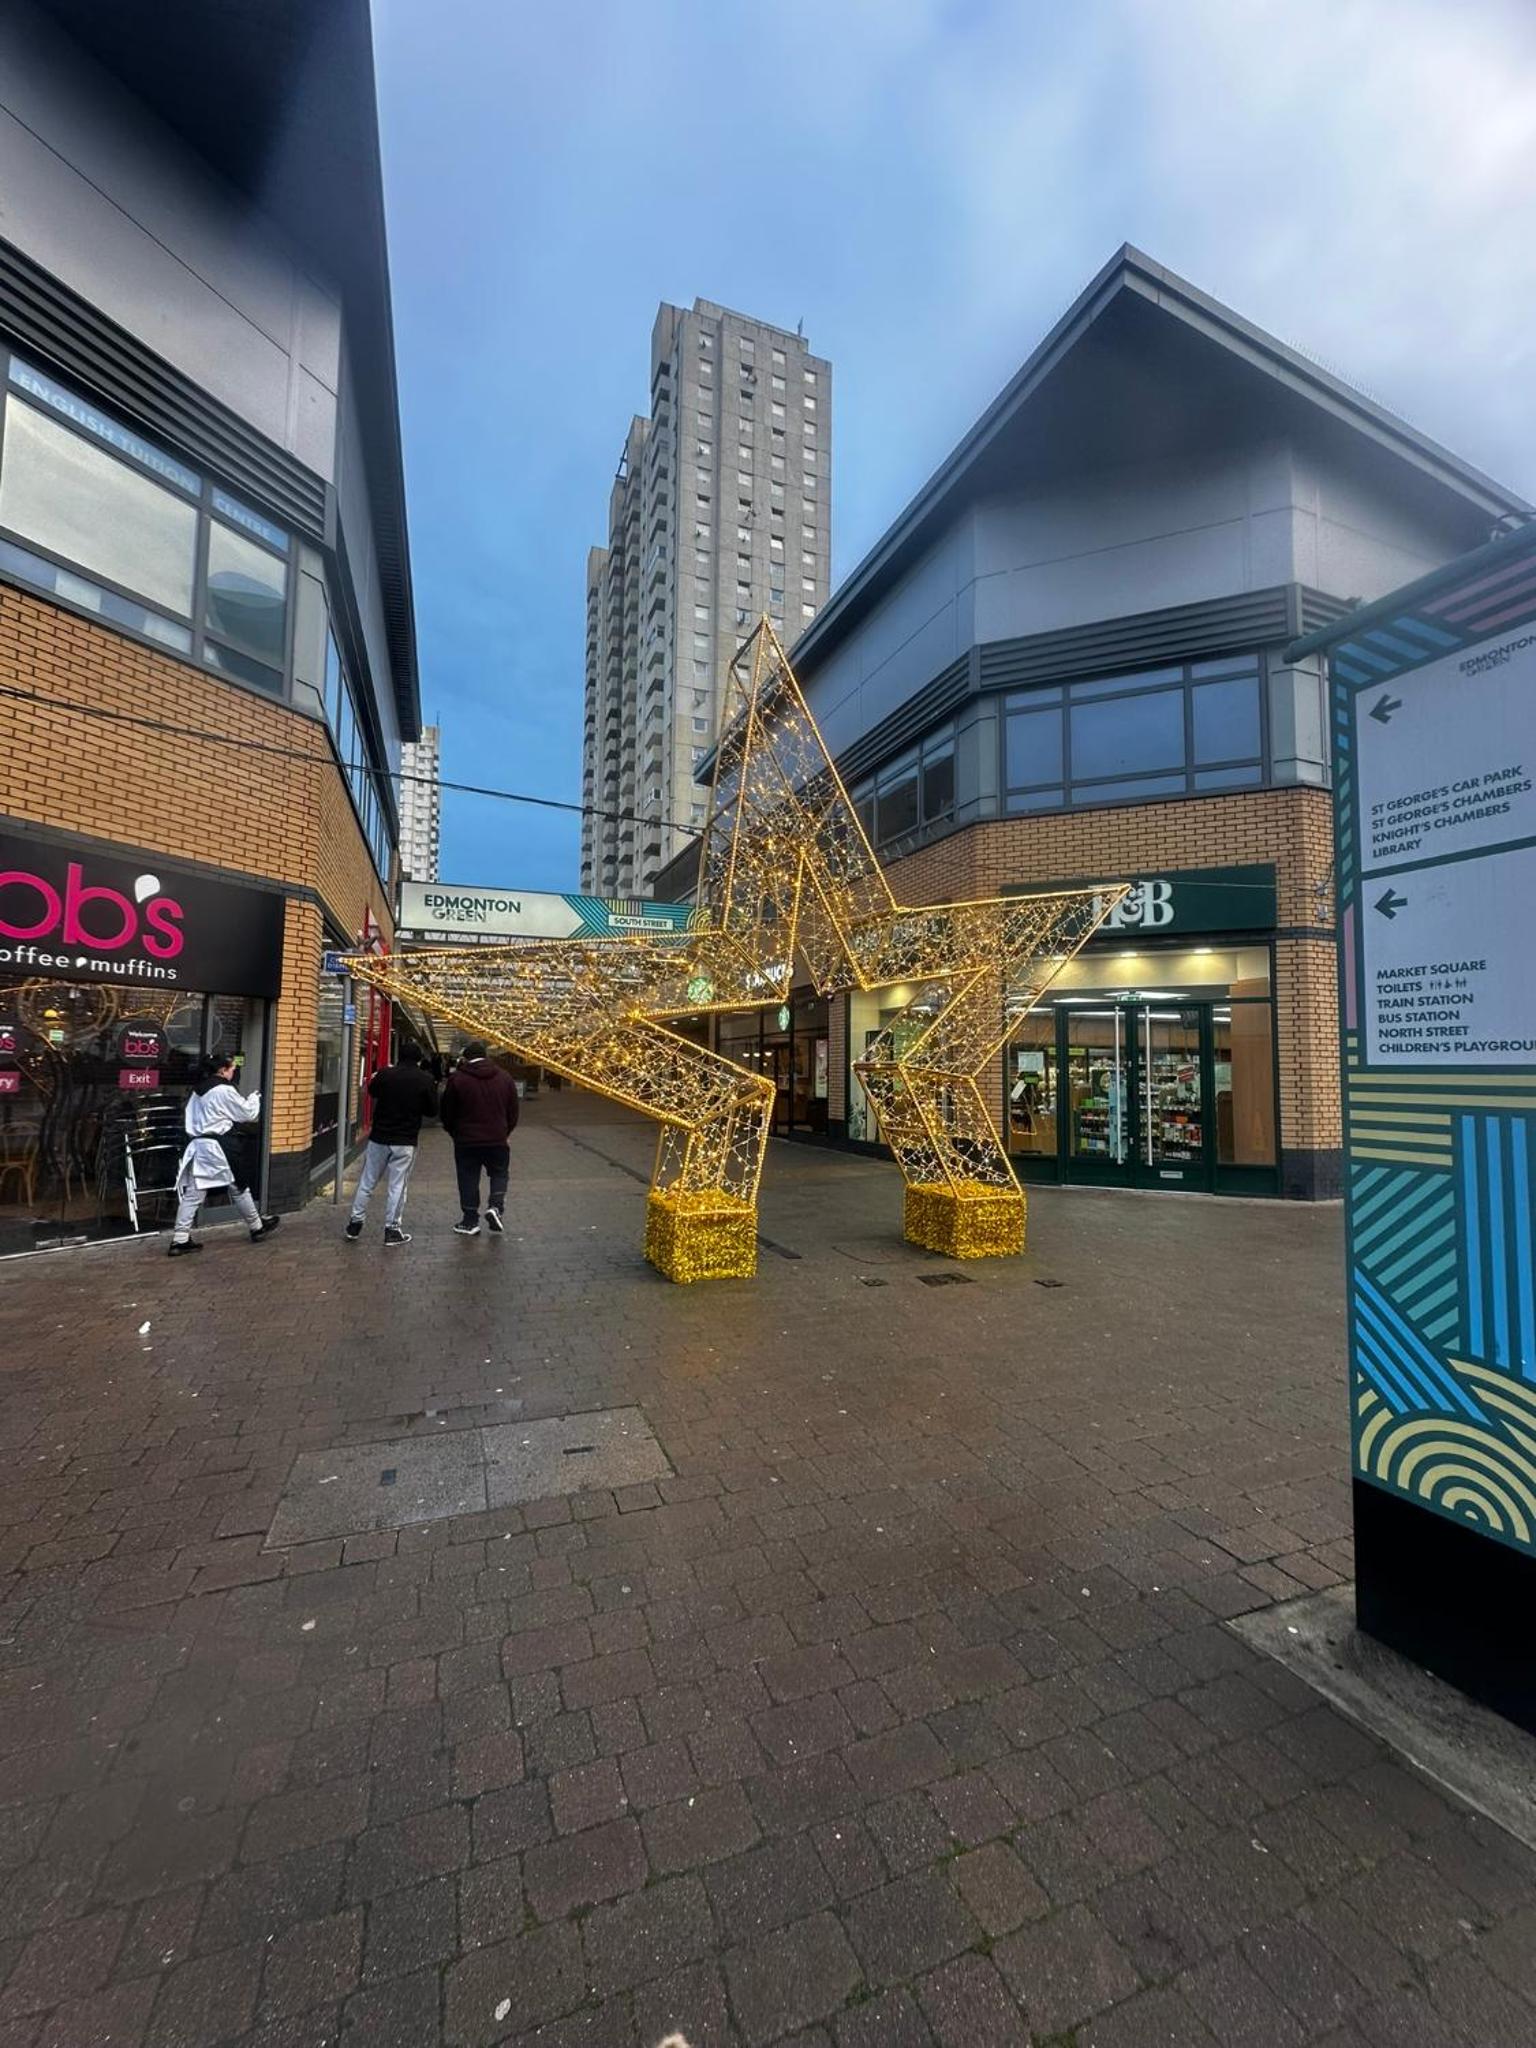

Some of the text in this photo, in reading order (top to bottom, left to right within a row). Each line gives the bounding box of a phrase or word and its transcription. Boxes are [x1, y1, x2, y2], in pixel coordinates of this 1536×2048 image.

[20, 372, 115, 440] ENGLISH
[1371, 765, 1523, 816] ST GEORGE'S CAR PARK
[1371, 779, 1533, 830] ST GEORGE'S CHAMBERS
[1372, 801, 1511, 844] KNIGHT'S CHAMBERS
[1372, 838, 1422, 859] LIBRARY
[424, 894, 521, 913] EDMONTON
[432, 907, 487, 922] GREEN
[614, 916, 668, 928] SOUTH STREET
[0, 945, 178, 980] offee muffins
[1376, 960, 1487, 980] MARKET SQUARE
[1376, 981, 1423, 994] TOILETS
[1377, 993, 1474, 1009] TRAIN STATION
[1378, 1010, 1460, 1024] BUS STATION
[1378, 1026, 1470, 1039] NORTH STREET
[1379, 1039, 1536, 1053] CHILDREN'S PLAYGROU
[129, 1073, 150, 1084] Exit
